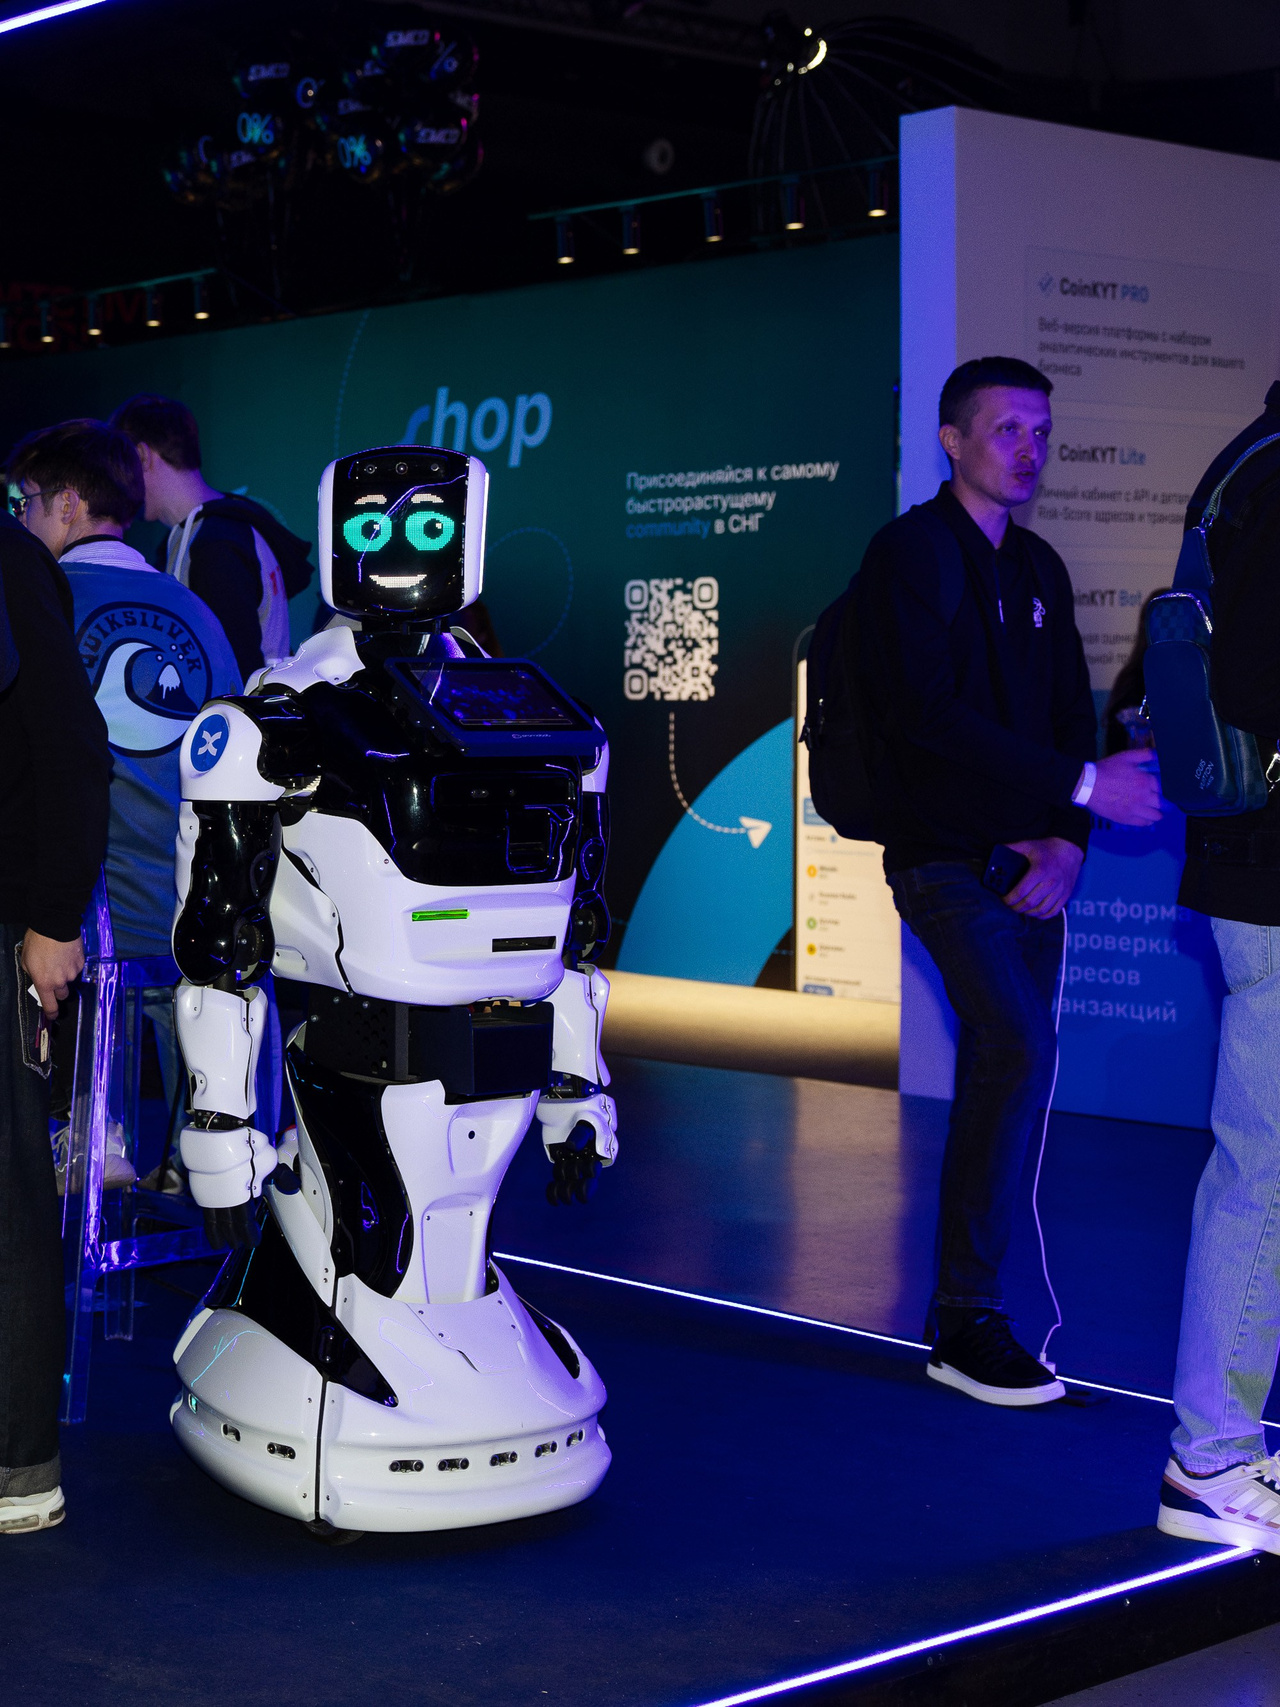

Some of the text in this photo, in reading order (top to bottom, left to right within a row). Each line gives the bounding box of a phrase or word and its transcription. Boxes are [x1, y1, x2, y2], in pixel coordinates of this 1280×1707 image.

[1059, 277, 1150, 303] CoinKYT PRO
[1059, 444, 1147, 466] CoinKYT Lite
[626, 460, 840, 491] Присоединяйся к самому
[625, 490, 777, 516] быстрорастущему
[625, 512, 765, 539] community в СНГ
[1074, 588, 1116, 607] inKYT
[81, 610, 202, 673] QUIKSILVER
[1069, 897, 1192, 924] латформа
[1060, 964, 1141, 986] ресов
[1053, 997, 1177, 1022] анзакций
